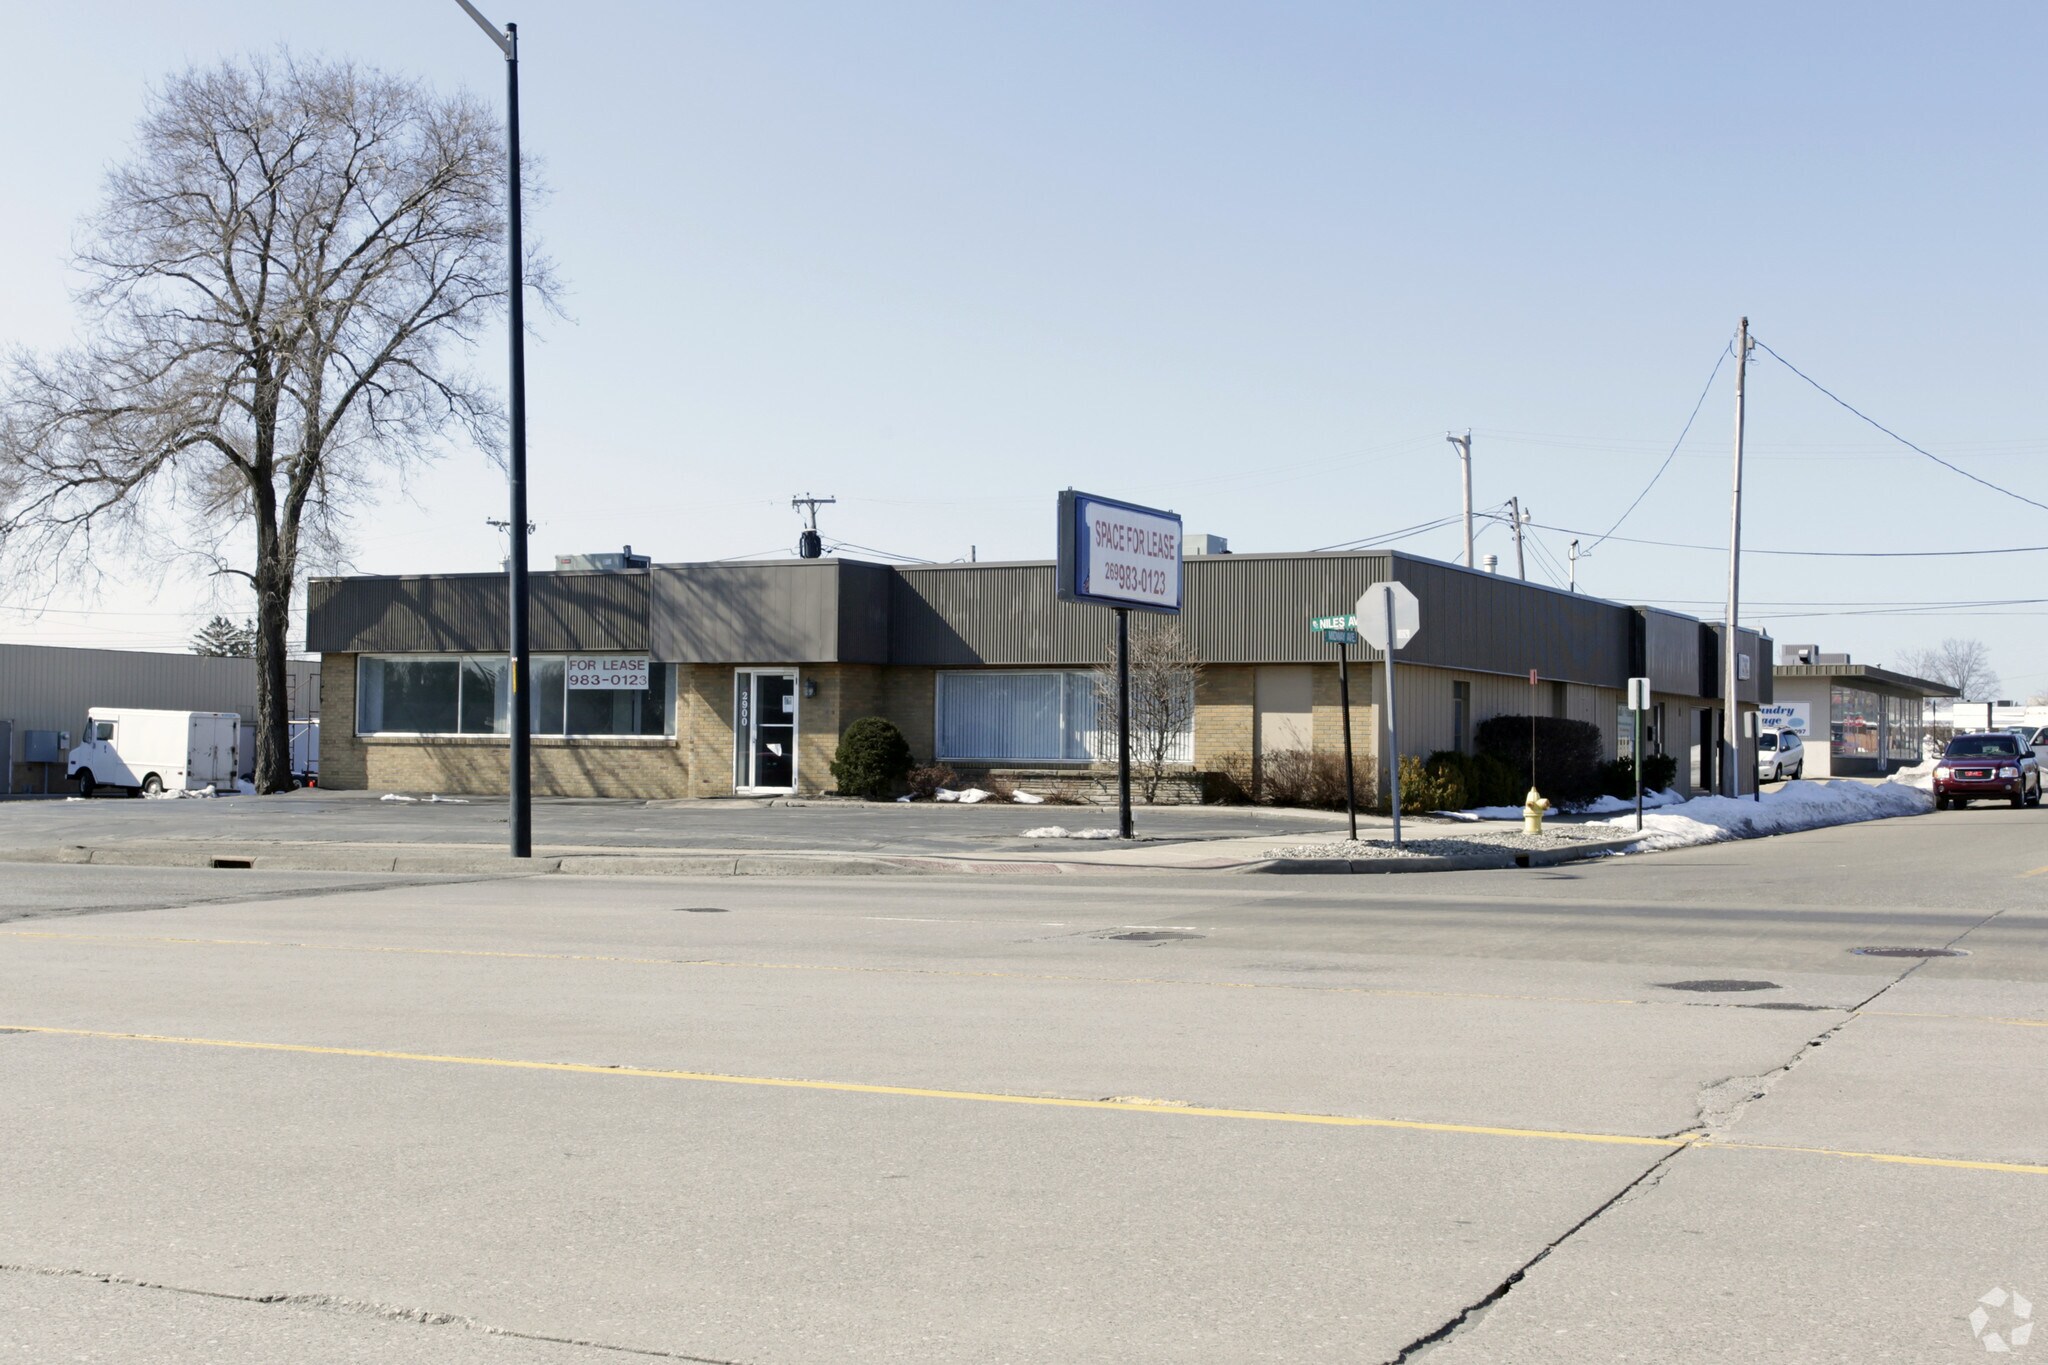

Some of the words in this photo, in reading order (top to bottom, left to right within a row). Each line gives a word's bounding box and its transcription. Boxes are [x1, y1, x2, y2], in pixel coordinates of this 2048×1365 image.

[1095, 519, 1125, 552] SPACE
[1127, 526, 1145, 556] FOR
[1147, 530, 1175, 560] LEASE
[1319, 616, 1345, 629] NILES
[1348, 615, 1357, 627] AV
[569, 660, 596, 671] FOR
[602, 660, 645, 671] LEASE
[569, 674, 647, 686] 983-0123
[1759, 705, 1795, 717] undry
[1762, 718, 1782, 727] age
